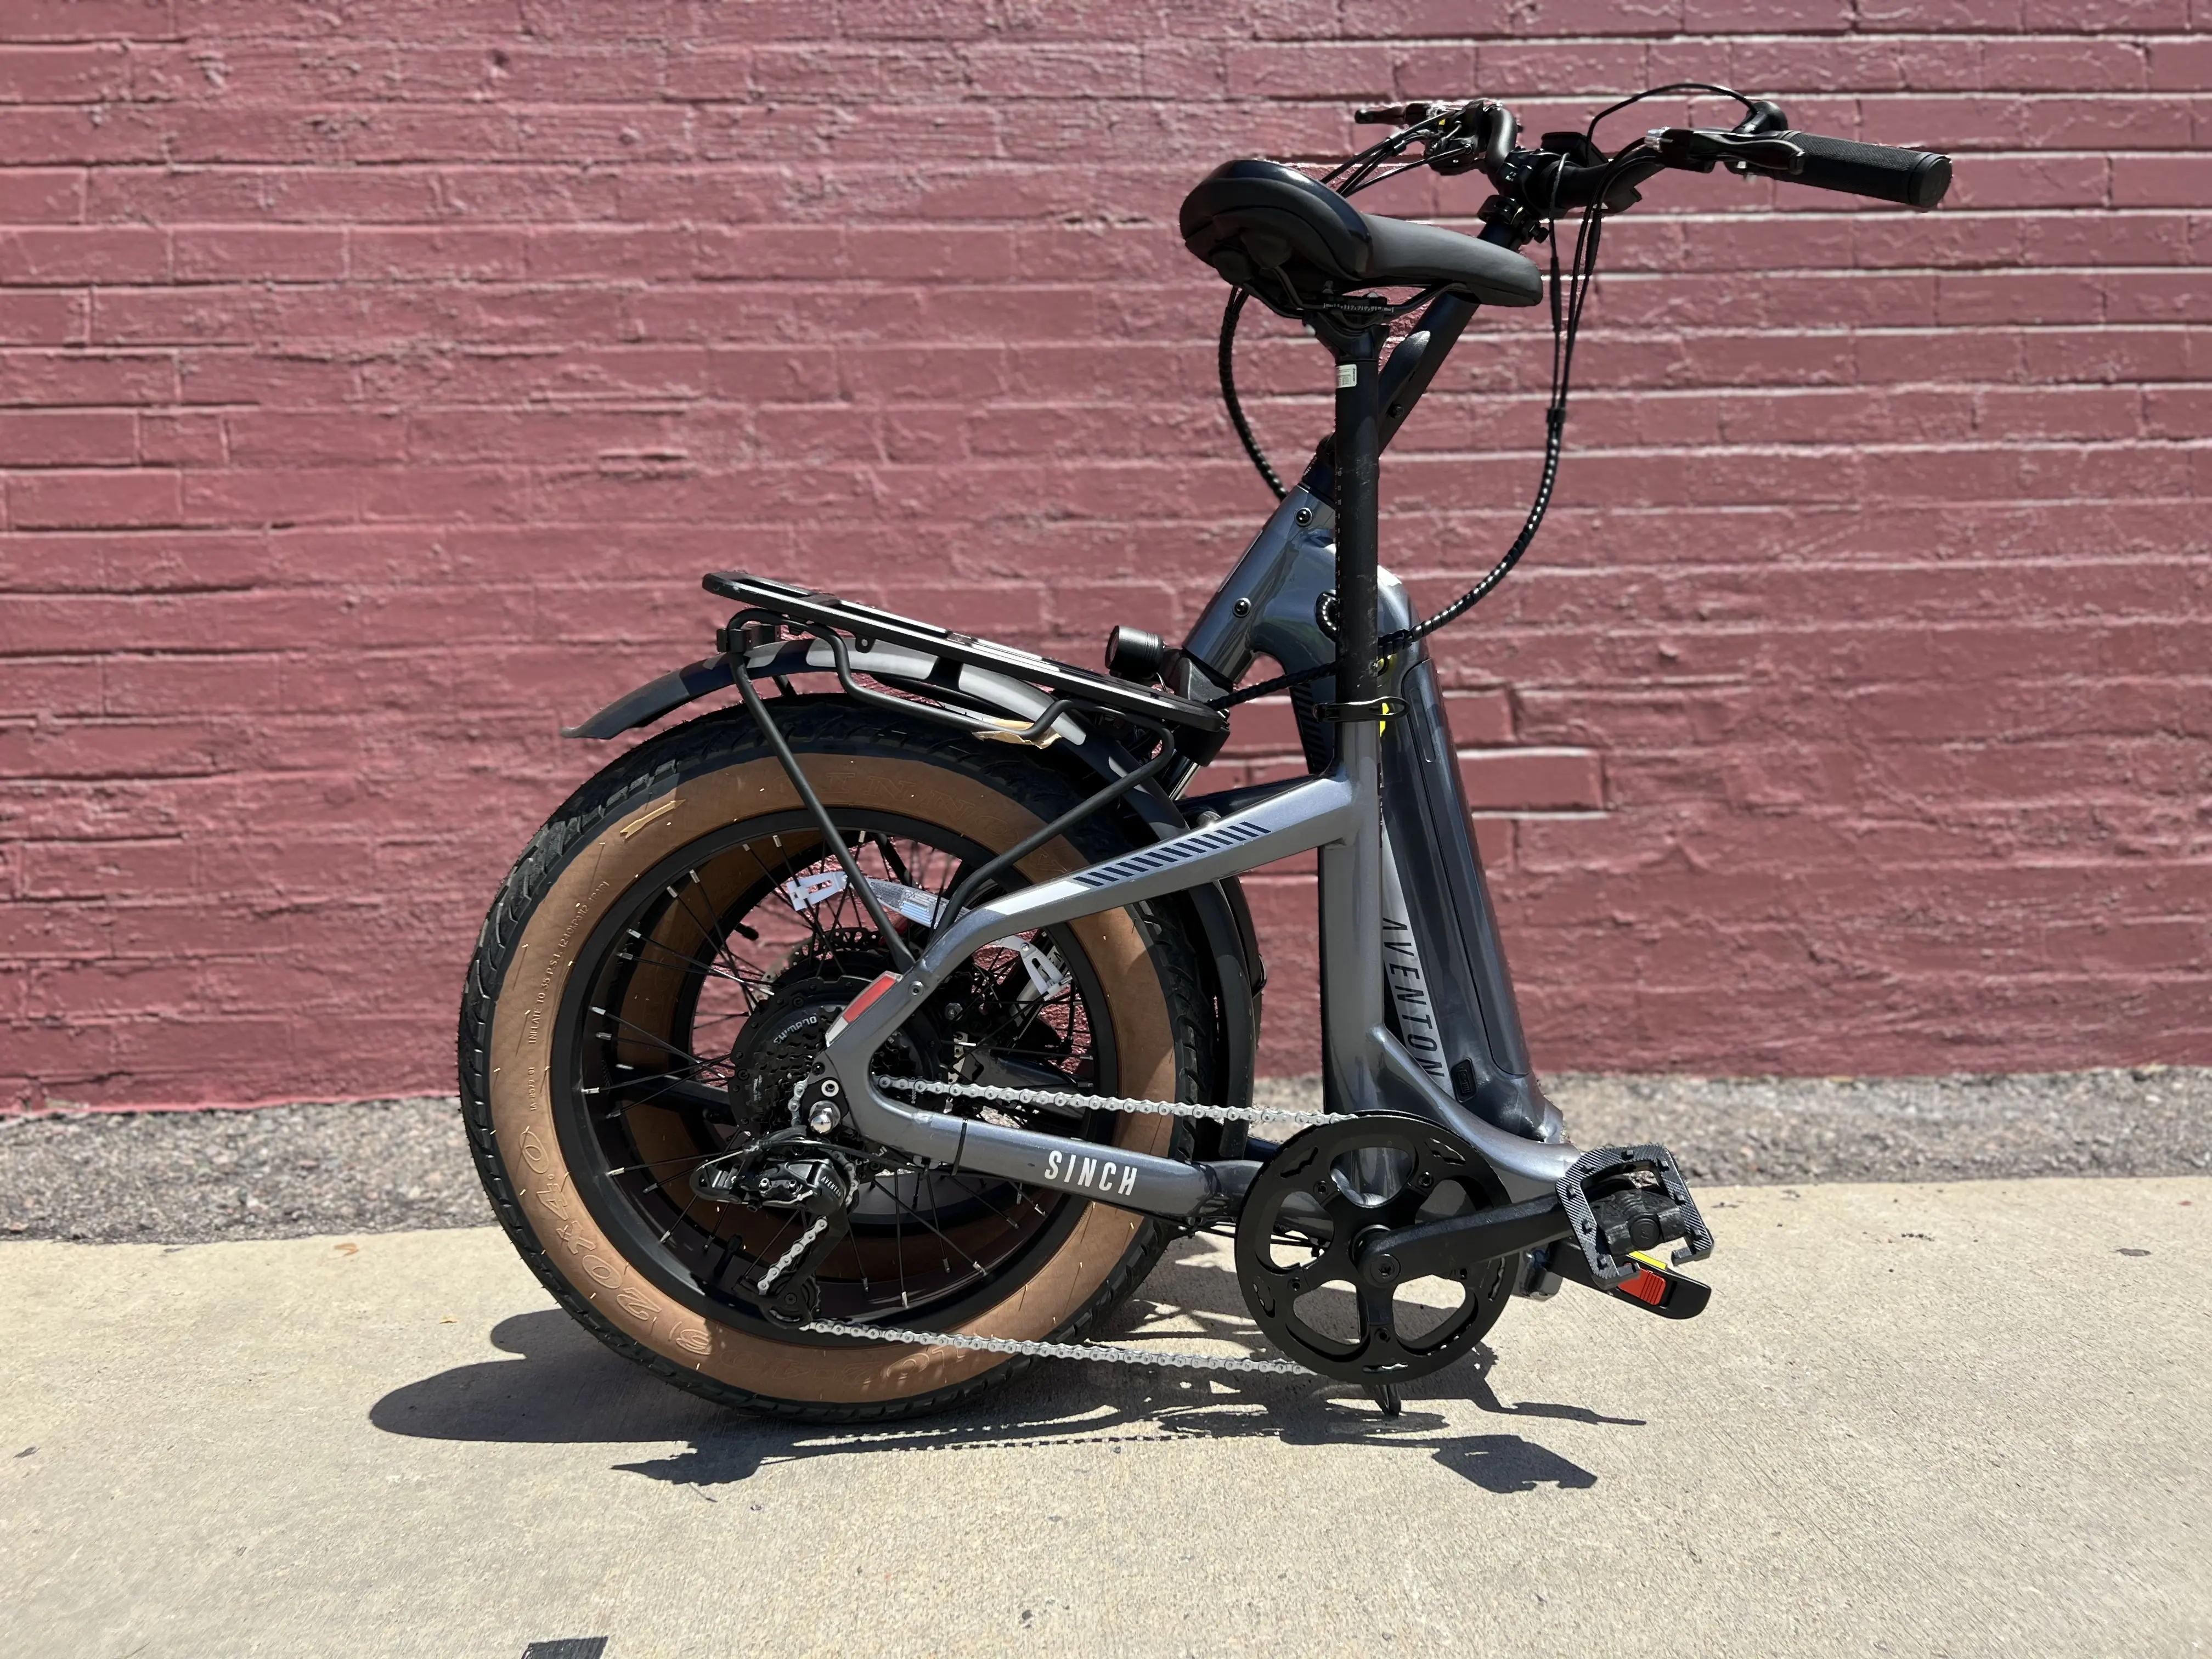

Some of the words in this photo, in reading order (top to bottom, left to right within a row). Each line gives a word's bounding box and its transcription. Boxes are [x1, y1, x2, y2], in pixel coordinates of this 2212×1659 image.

[1382, 917, 1445, 1077] AVENTON
[773, 1015, 817, 1044] SHIMANO
[820, 1176, 842, 1197] AVENTON
[1044, 1150, 1137, 1196] SINCH
